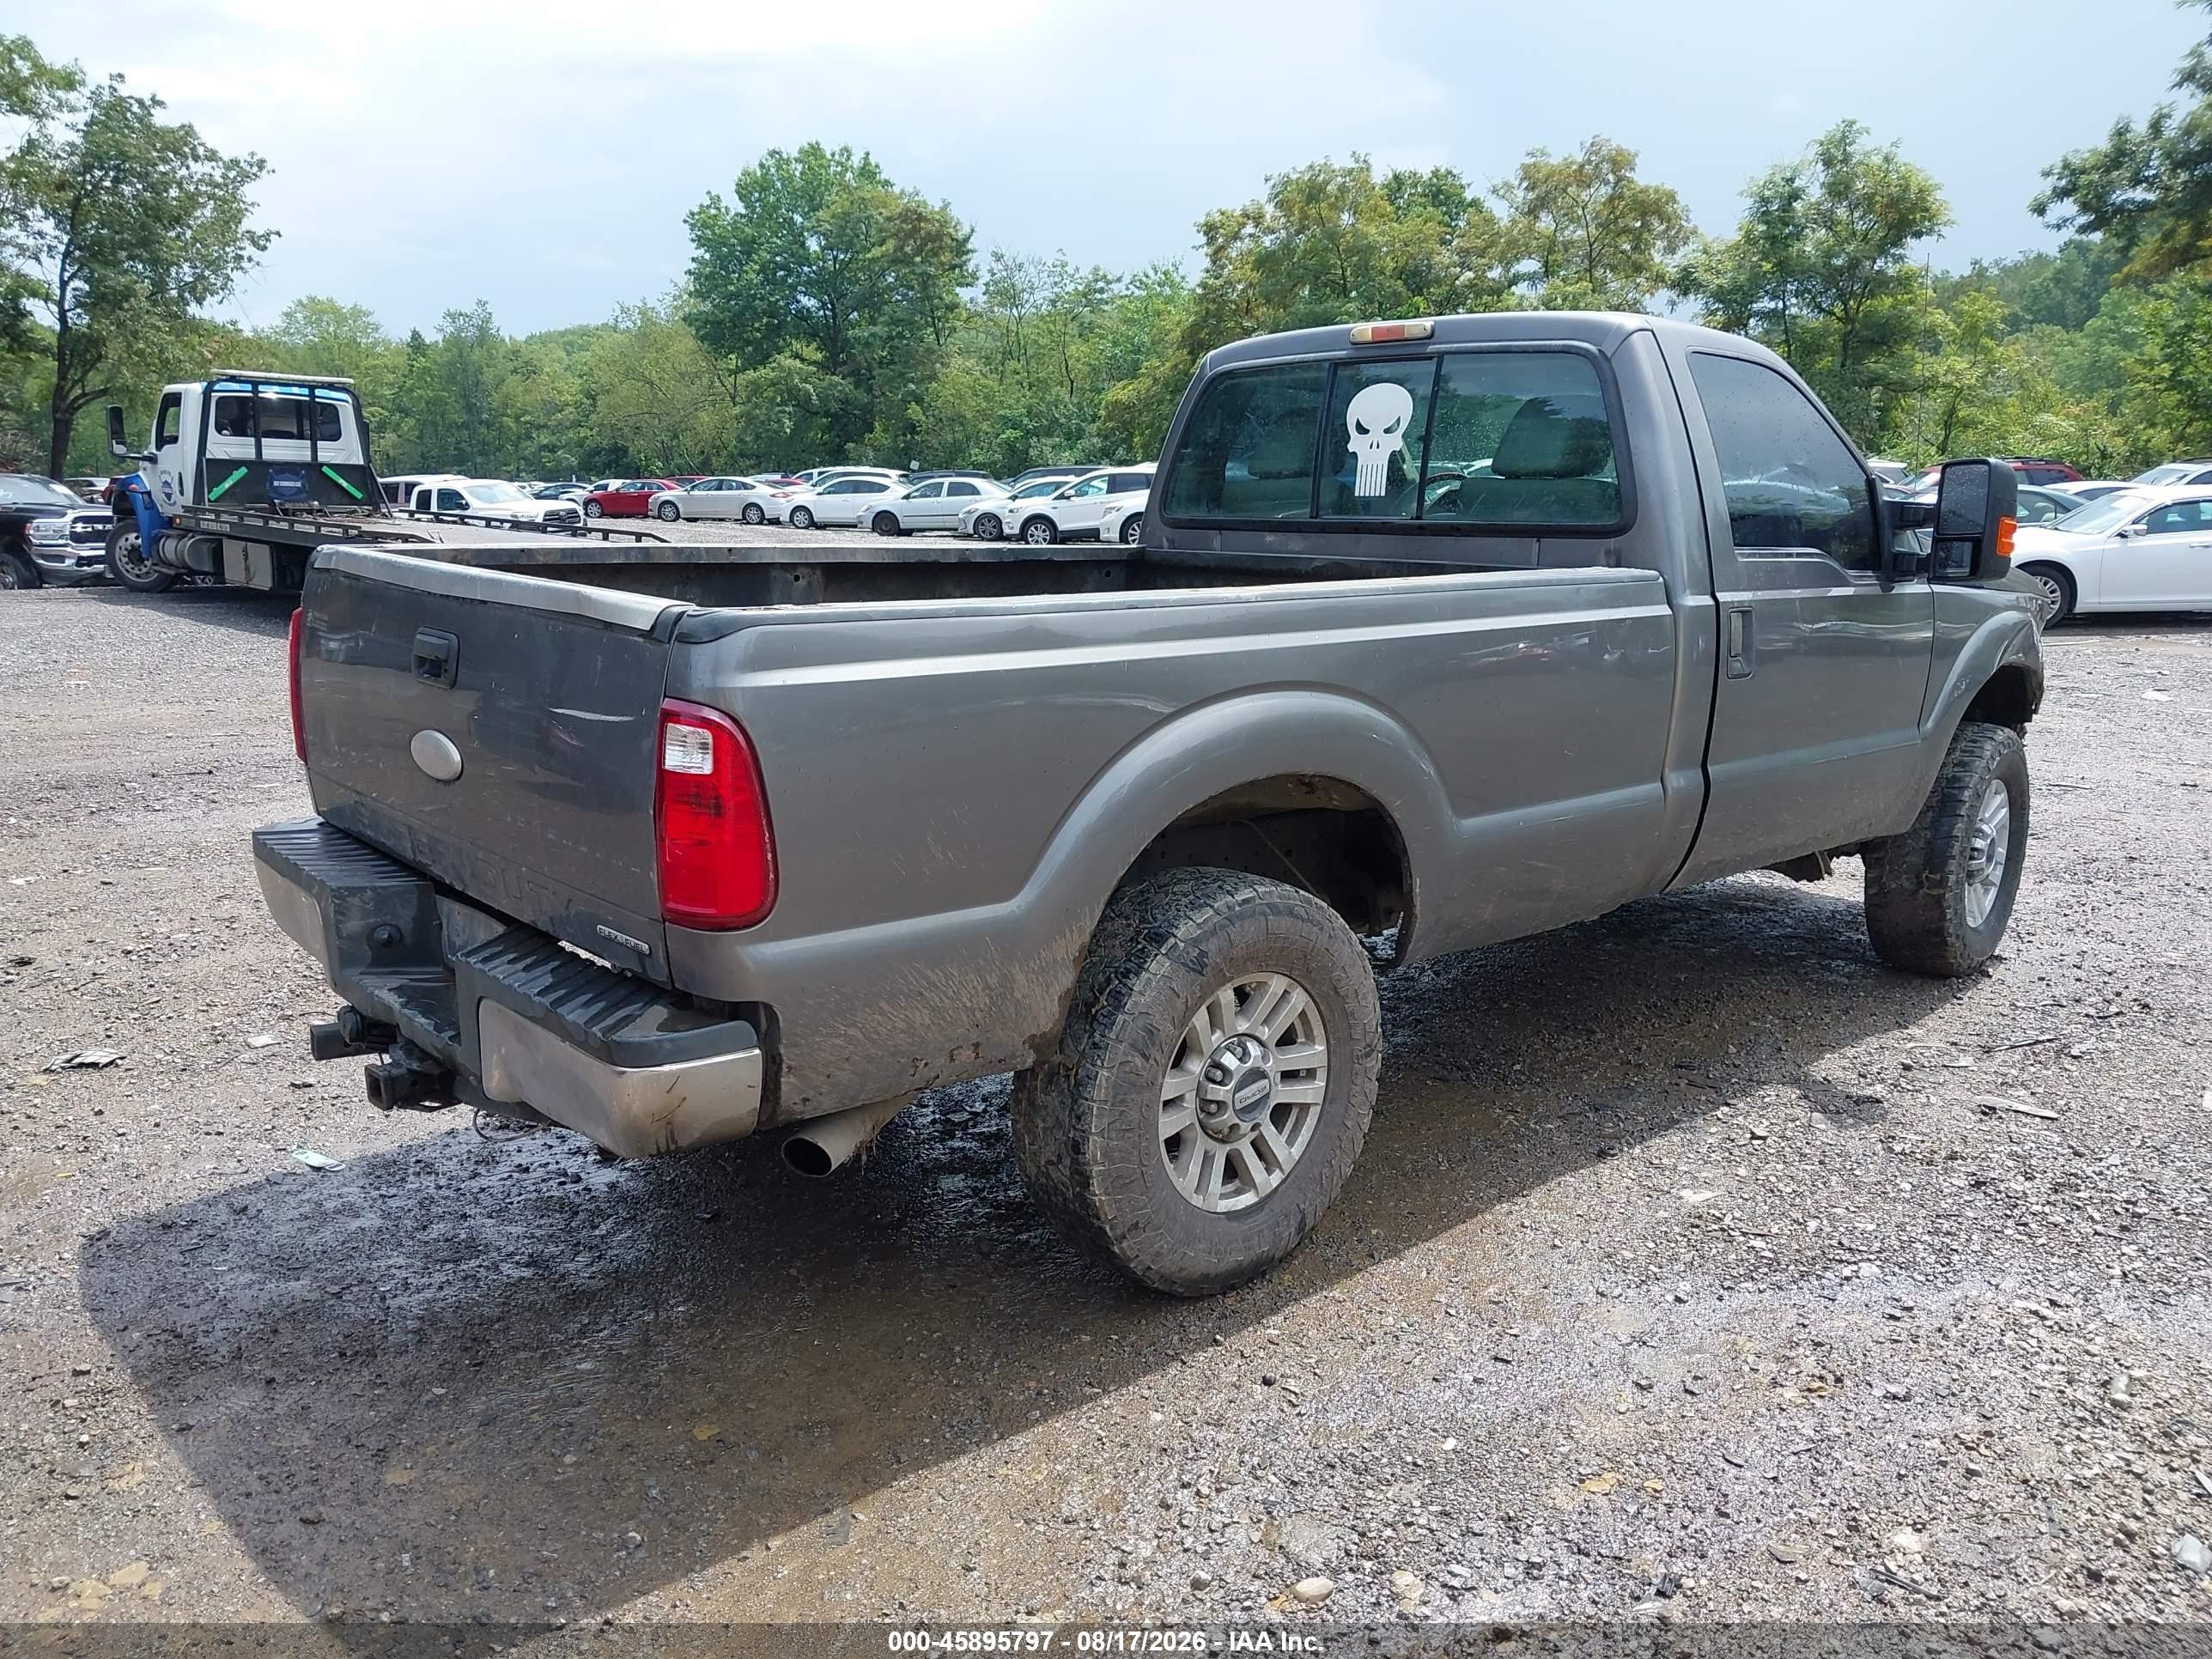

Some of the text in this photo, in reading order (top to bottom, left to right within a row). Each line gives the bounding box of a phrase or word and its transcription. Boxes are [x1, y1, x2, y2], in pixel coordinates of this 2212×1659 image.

[599, 927, 647, 954] FLEX FUEL
[1239, 1085, 1267, 1104] FORD
